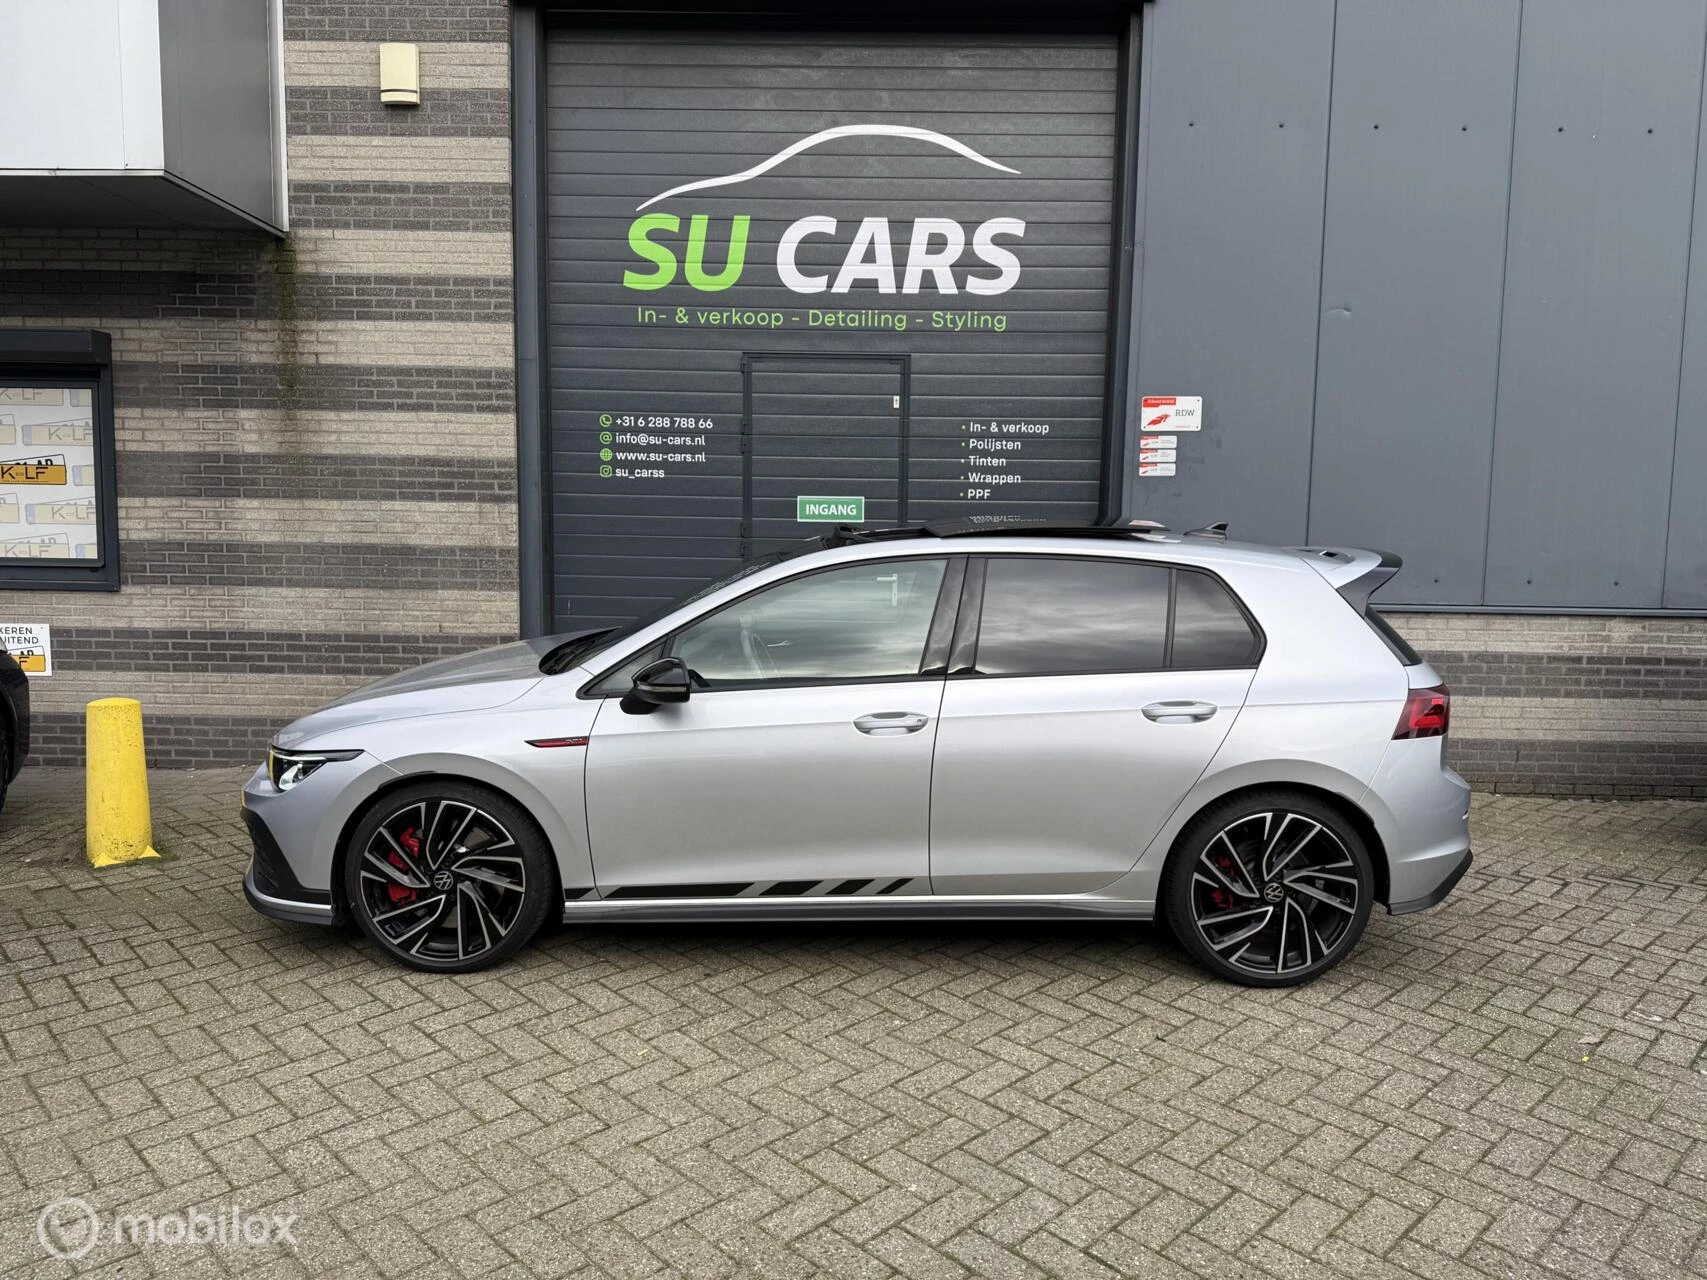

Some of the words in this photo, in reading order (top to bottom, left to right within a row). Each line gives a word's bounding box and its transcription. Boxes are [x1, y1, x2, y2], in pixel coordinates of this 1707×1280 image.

[623, 213, 750, 292] SU
[776, 215, 1026, 296] CARS
[637, 306, 667, 323] In-
[675, 307, 689, 324] &
[697, 308, 783, 328] verkoop
[808, 310, 907, 331] Detailing
[931, 311, 1007, 332] Styling
[1175, 409, 1195, 417] RDW
[615, 416, 634, 427] +31
[637, 416, 645, 427] 6
[648, 417, 670, 428] 288
[673, 417, 696, 428] 788
[698, 418, 713, 429] 66
[969, 421, 987, 432] In-
[990, 421, 999, 432] &
[1002, 422, 1050, 435] verkoop
[615, 433, 706, 446] info@su-cars.nl
[969, 438, 1022, 451] Polijsten
[615, 451, 706, 463] www.su-cars.nl
[968, 455, 1006, 466] Tinten
[615, 467, 665, 479] su_carss
[968, 472, 1022, 485] Wrappen
[967, 489, 991, 499] PPF
[805, 504, 857, 515] INGANG
